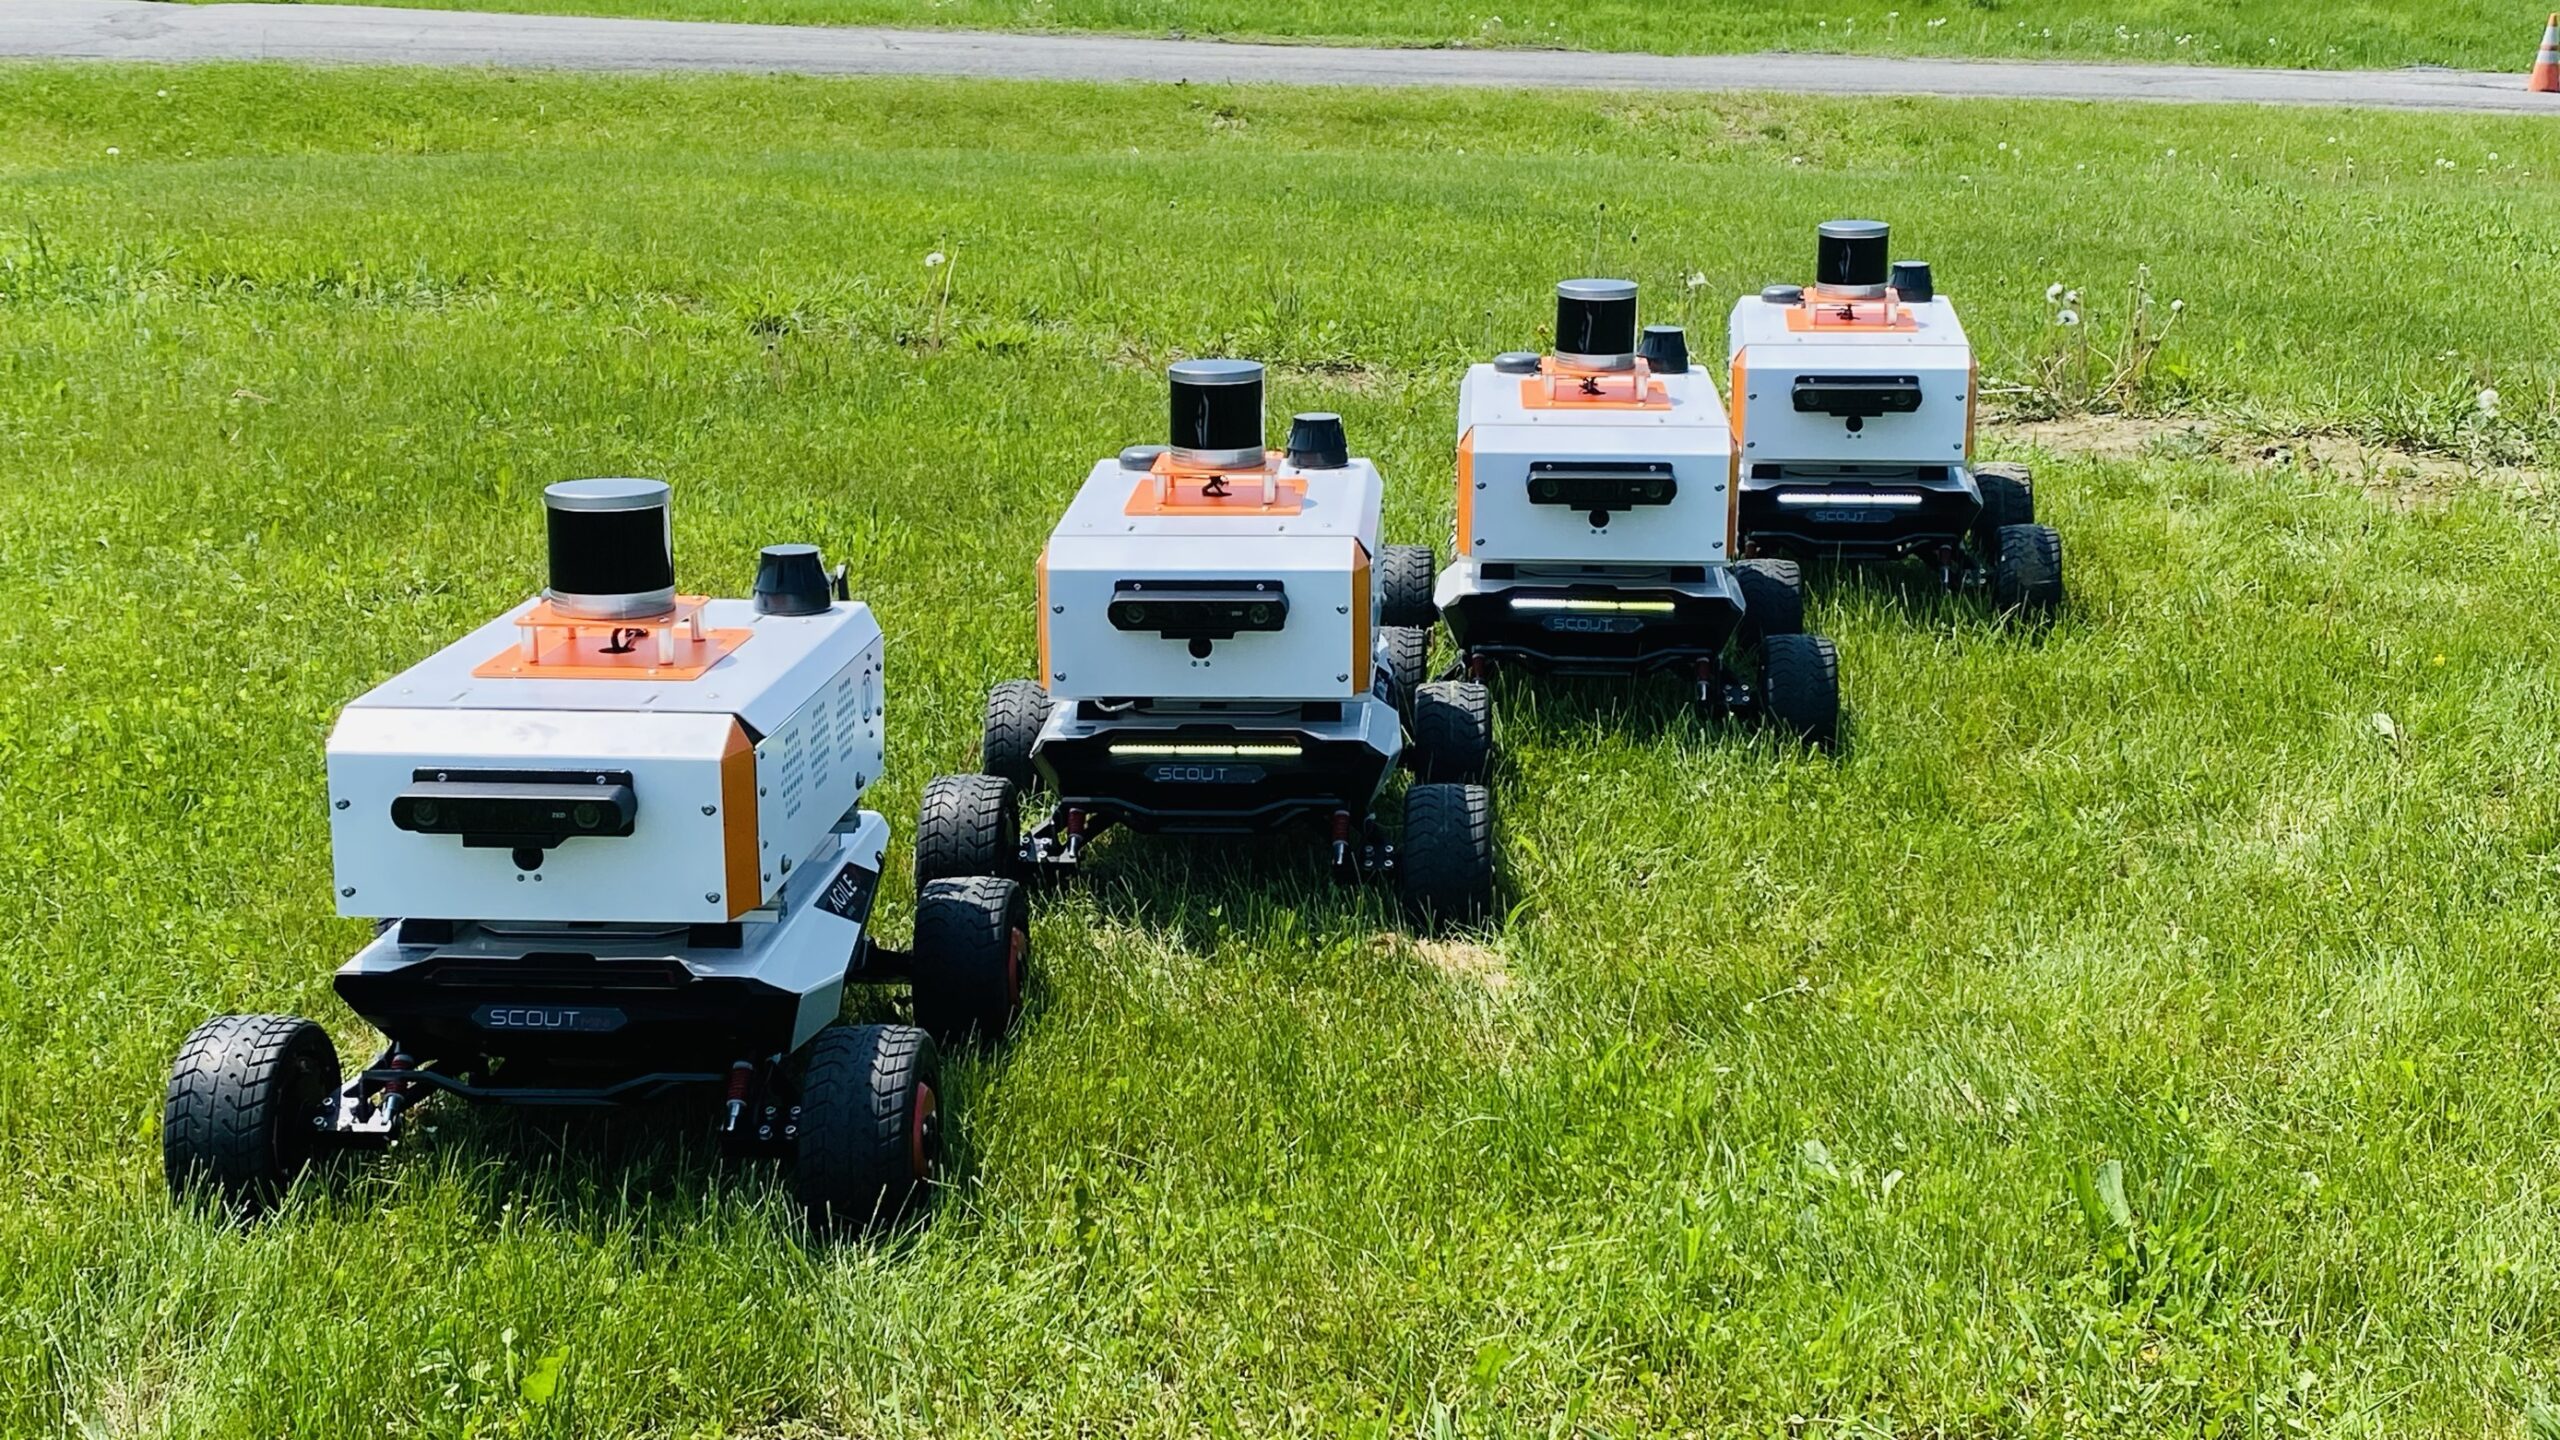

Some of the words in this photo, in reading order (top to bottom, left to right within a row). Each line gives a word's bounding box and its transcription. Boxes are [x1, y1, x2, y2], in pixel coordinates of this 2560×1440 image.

[1816, 511, 1866, 521] SCOUT
[1554, 618, 1612, 631] SCOUT
[1158, 767, 1228, 780] SCOUT
[828, 873, 858, 913] AGILE
[490, 1009, 580, 1026] SCOUT
